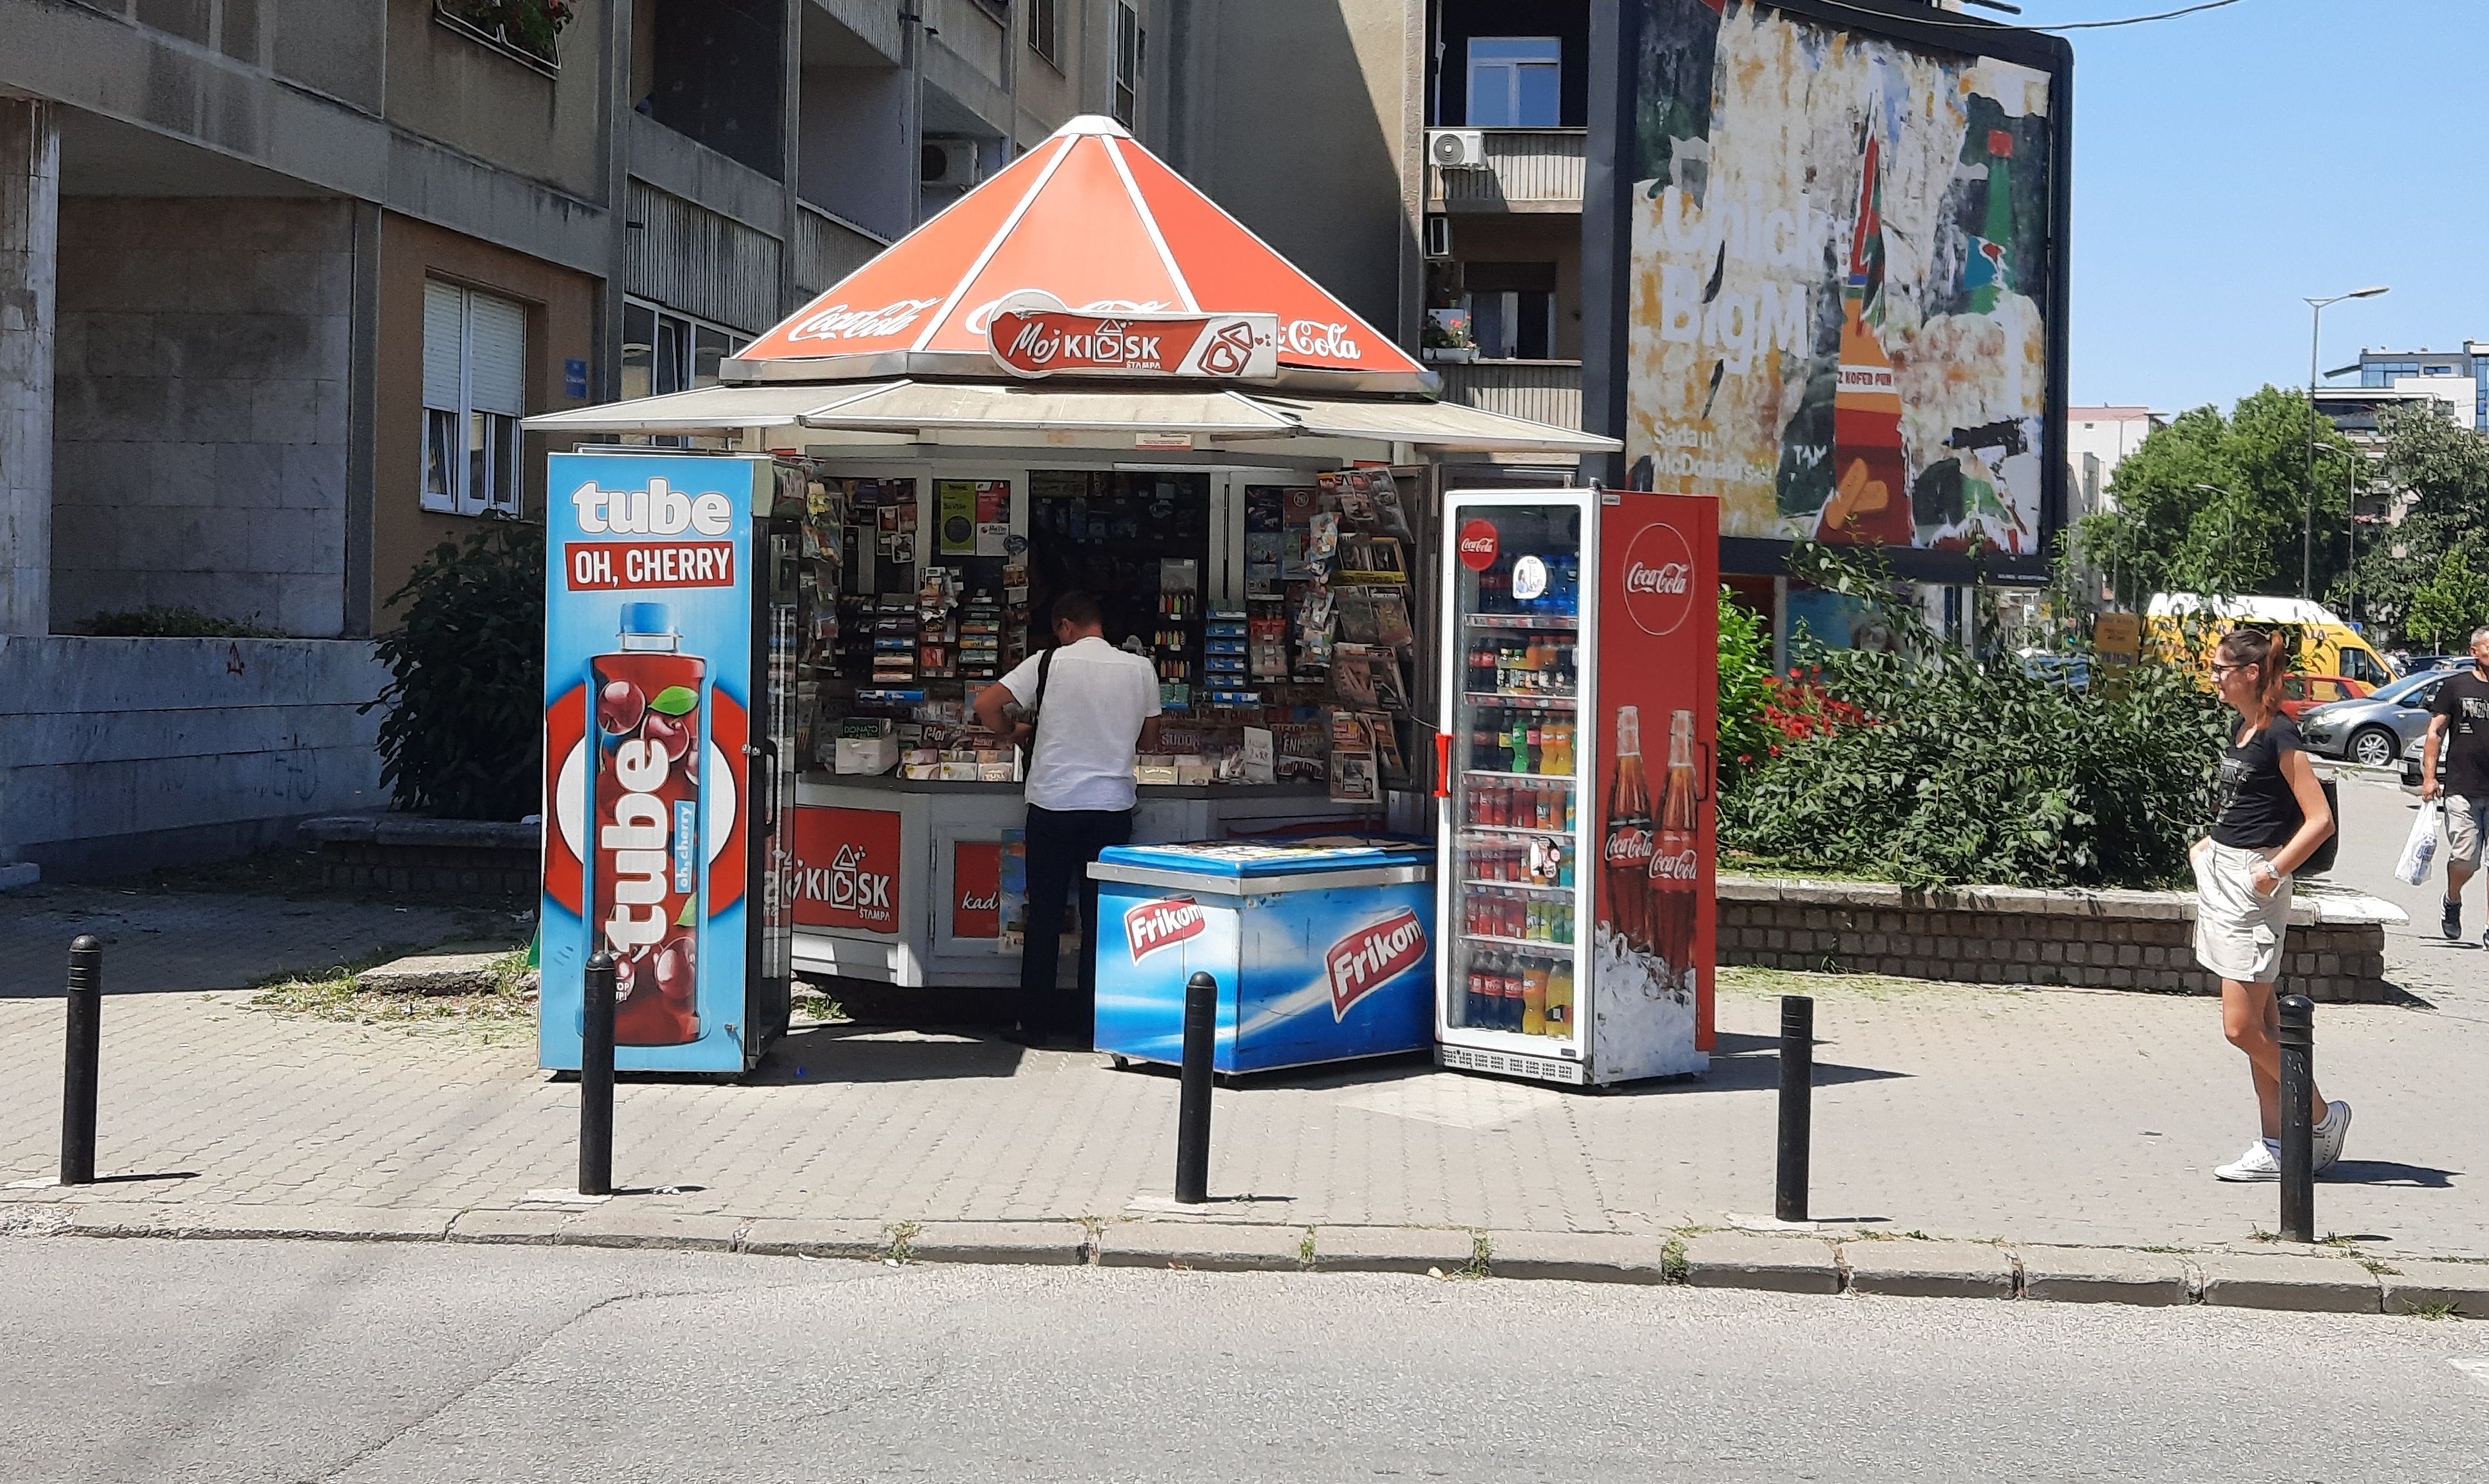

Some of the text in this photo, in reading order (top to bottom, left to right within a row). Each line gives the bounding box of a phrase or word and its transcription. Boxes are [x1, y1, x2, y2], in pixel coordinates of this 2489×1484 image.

[1007, 321, 1061, 364] Moj
[571, 477, 731, 535] tube
[574, 547, 730, 587] OH, CHERRY
[602, 739, 670, 953] tube
[1131, 902, 1203, 949] Frikom
[1334, 919, 1424, 998] Frikom
